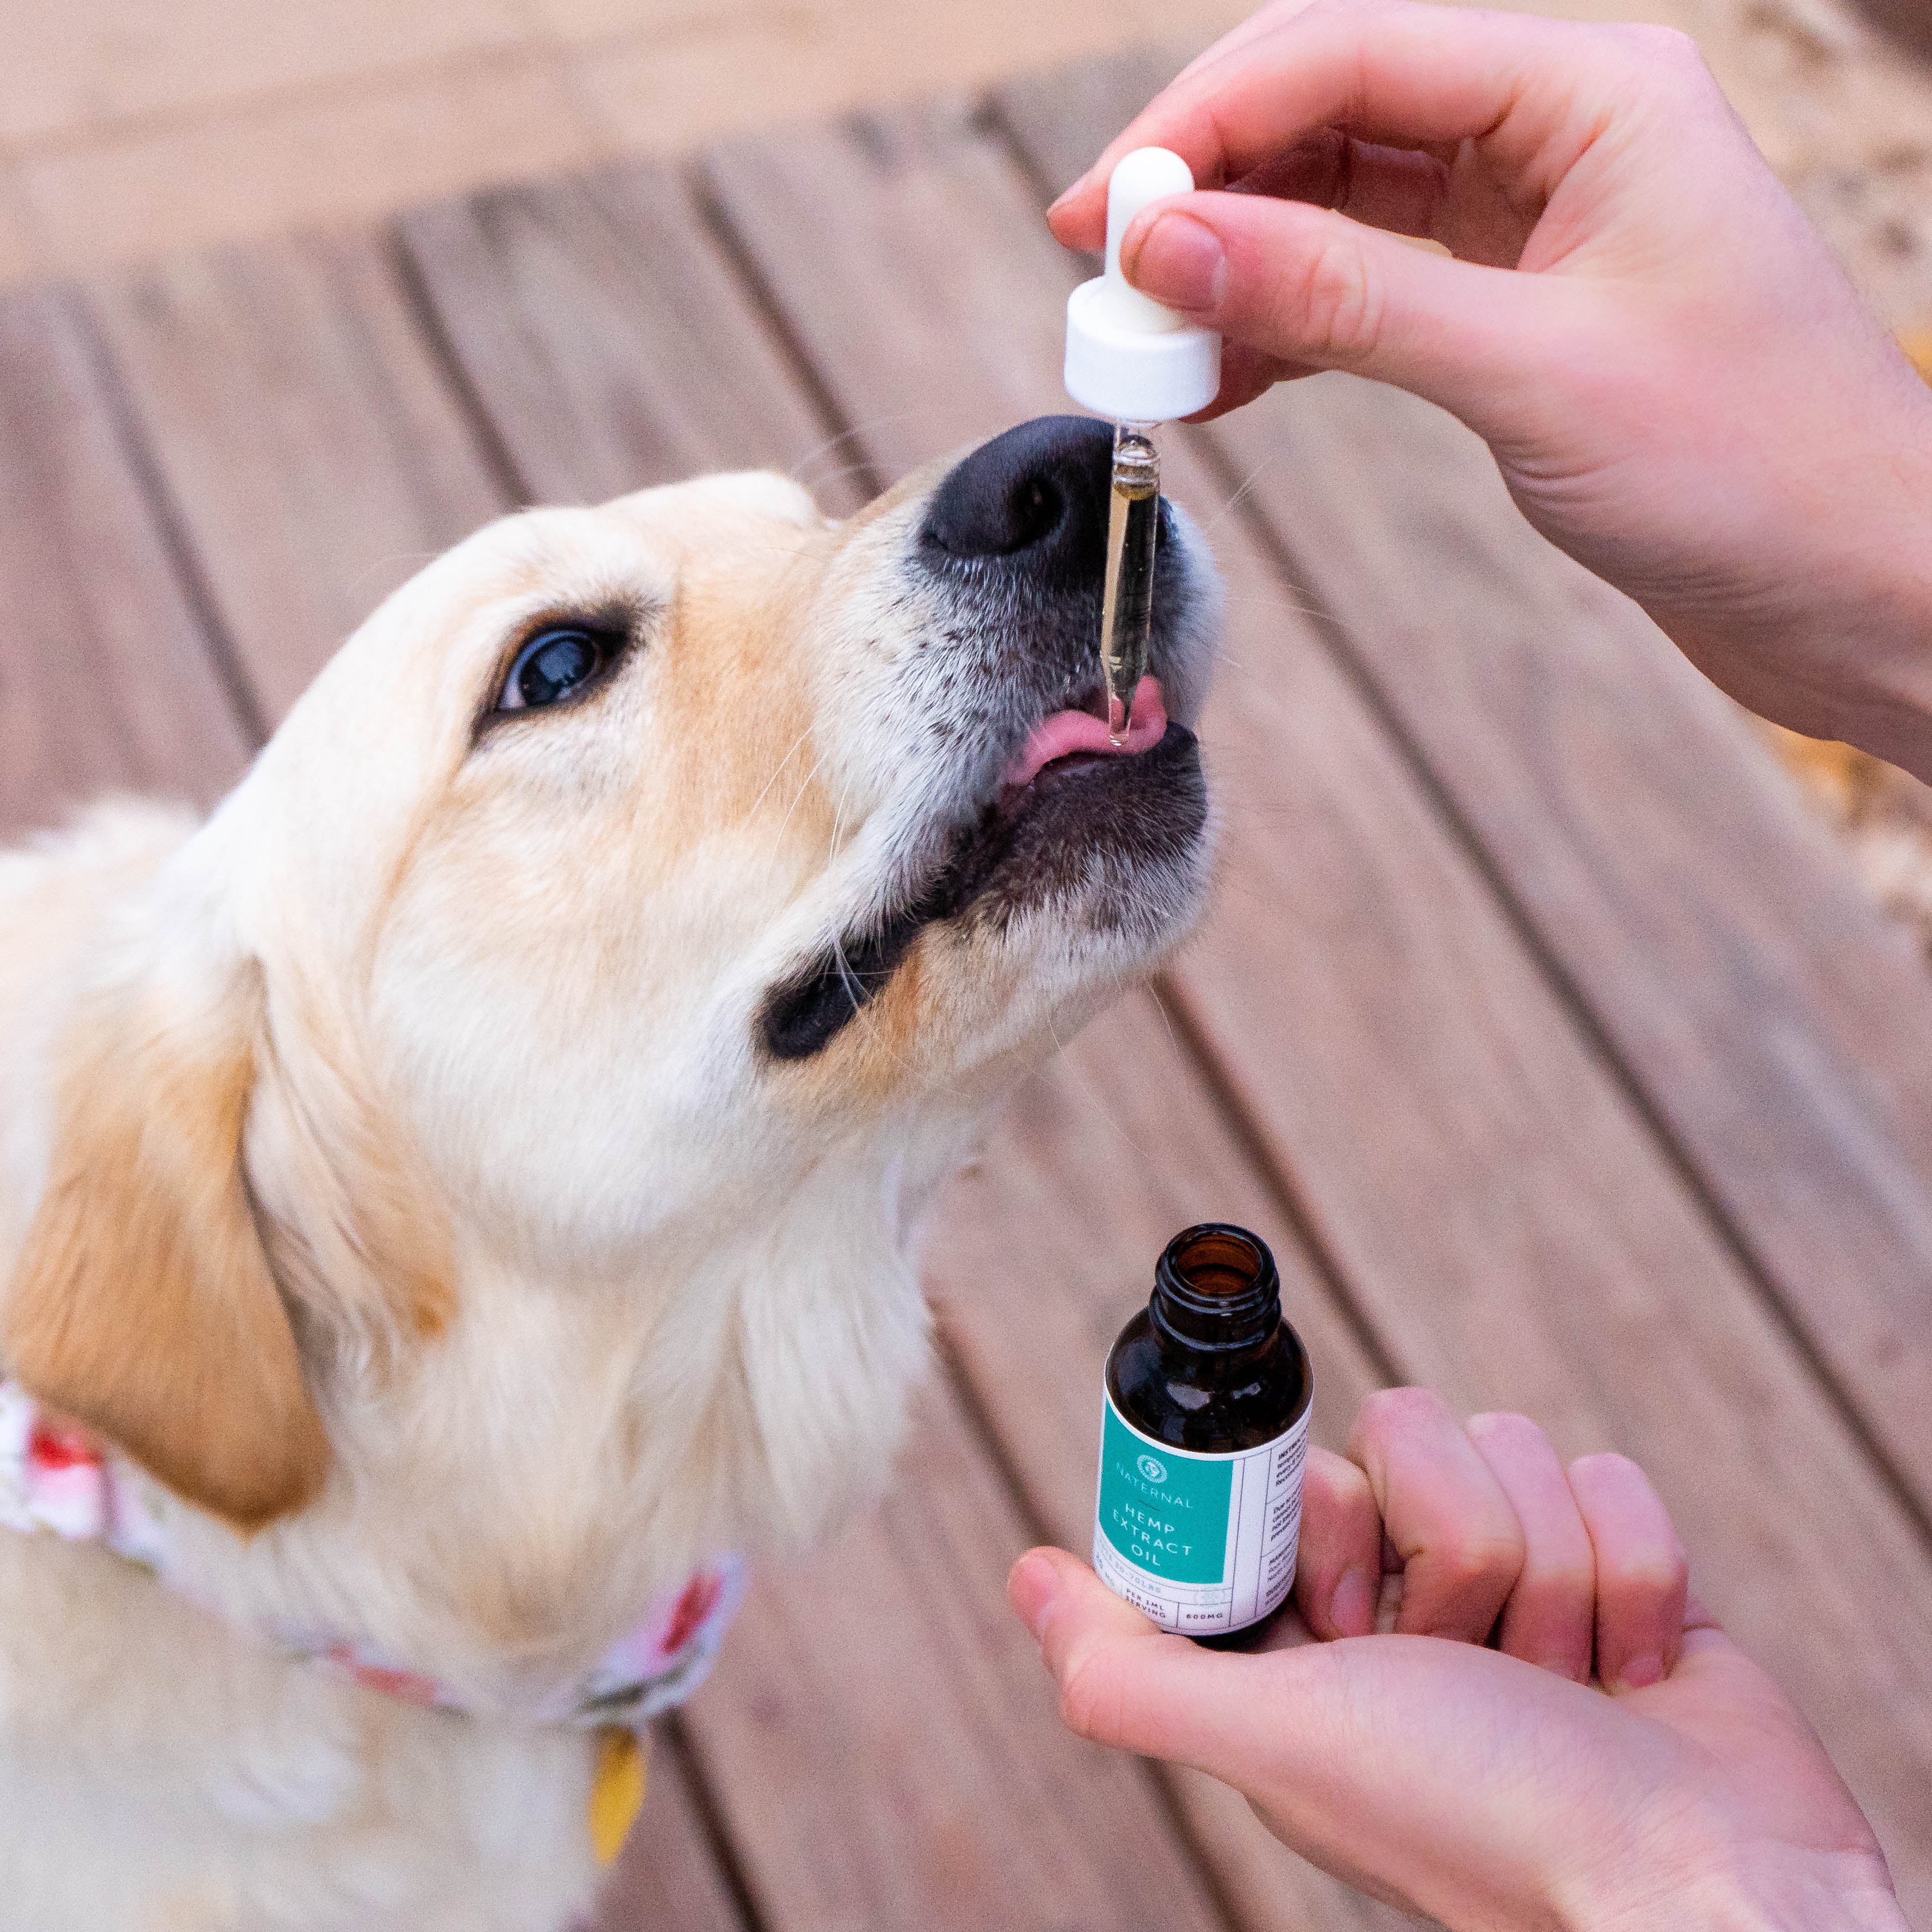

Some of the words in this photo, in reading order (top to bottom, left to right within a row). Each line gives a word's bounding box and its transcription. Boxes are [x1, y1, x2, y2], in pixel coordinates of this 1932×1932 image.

[1117, 1463, 1193, 1509] NATERNAL
[1126, 1503, 1174, 1534] HEMP
[1113, 1509, 1191, 1555] EXTRACT
[1131, 1544, 1161, 1566] OIL
[1126, 1589, 1142, 1601] PER
[1126, 1596, 1166, 1618] SERVING
